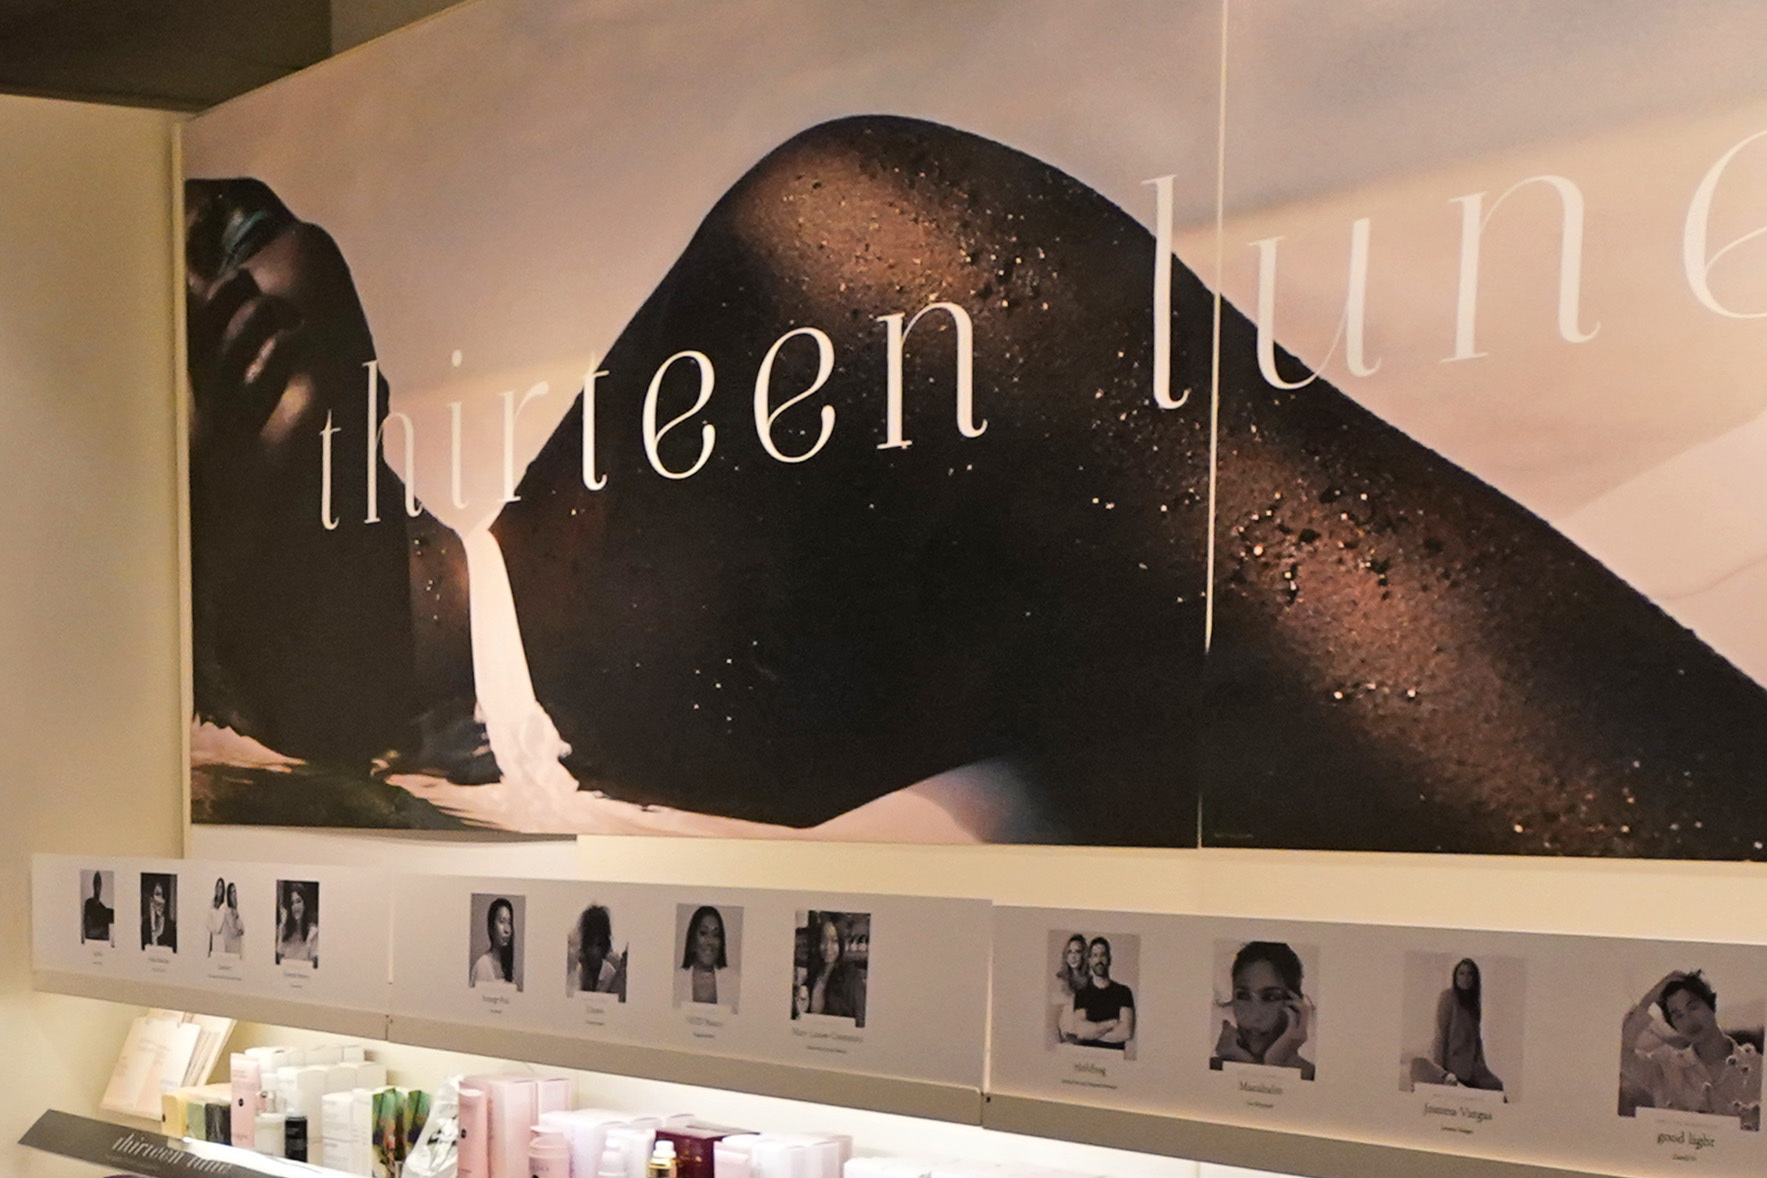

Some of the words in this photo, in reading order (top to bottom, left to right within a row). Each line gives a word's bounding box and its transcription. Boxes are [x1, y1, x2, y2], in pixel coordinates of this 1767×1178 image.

[318, 301, 988, 531] thirteen
[1143, 128, 1767, 409] lune
[1657, 1132, 1685, 1145] good
[1689, 1133, 1715, 1150] light
